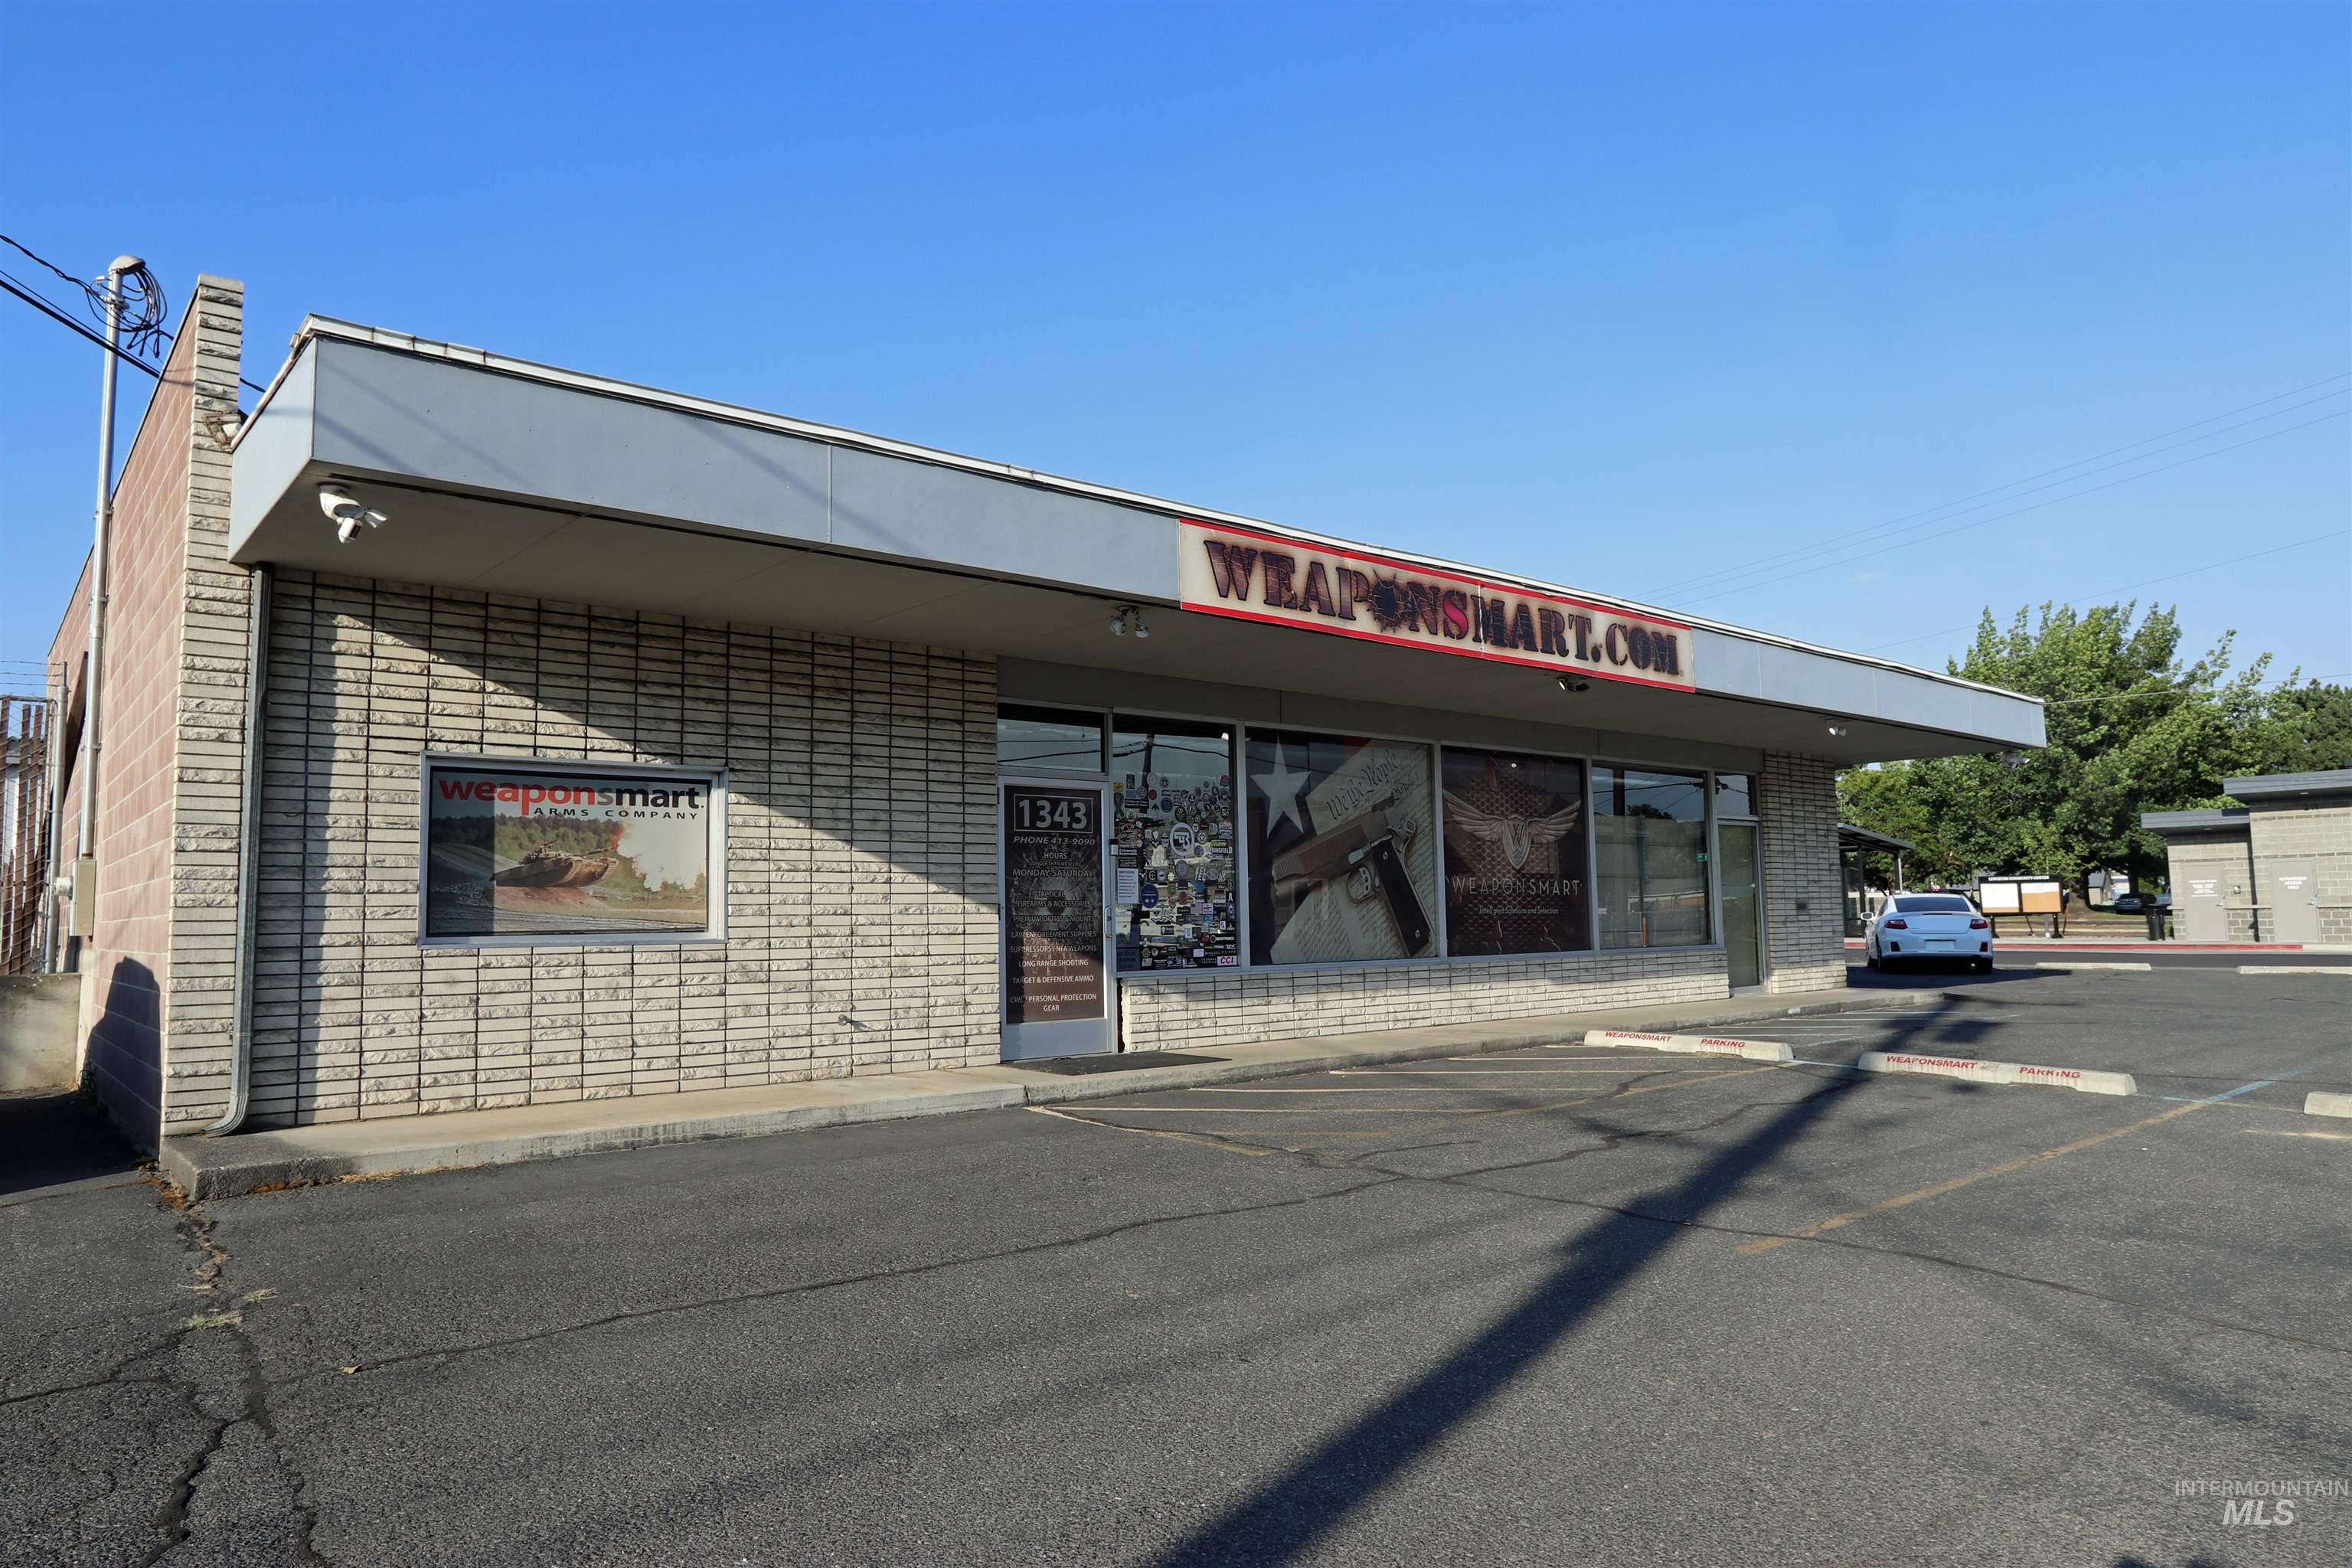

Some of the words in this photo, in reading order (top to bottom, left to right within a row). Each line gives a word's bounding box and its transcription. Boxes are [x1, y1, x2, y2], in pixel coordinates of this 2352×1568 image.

[1204, 539, 1679, 675] WEAPONSMART.COM
[534, 807, 589, 817] ARMS
[606, 809, 698, 820] COMPANY
[1019, 799, 1087, 829] 1343
[1452, 877, 1580, 895] WEAPONSMART
[1605, 1031, 1672, 1042] WEAPONSMART
[1700, 1038, 1746, 1047] PARKING
[1886, 1055, 1978, 1069] WEAPONSMART
[2020, 1067, 2081, 1079] PARKING
